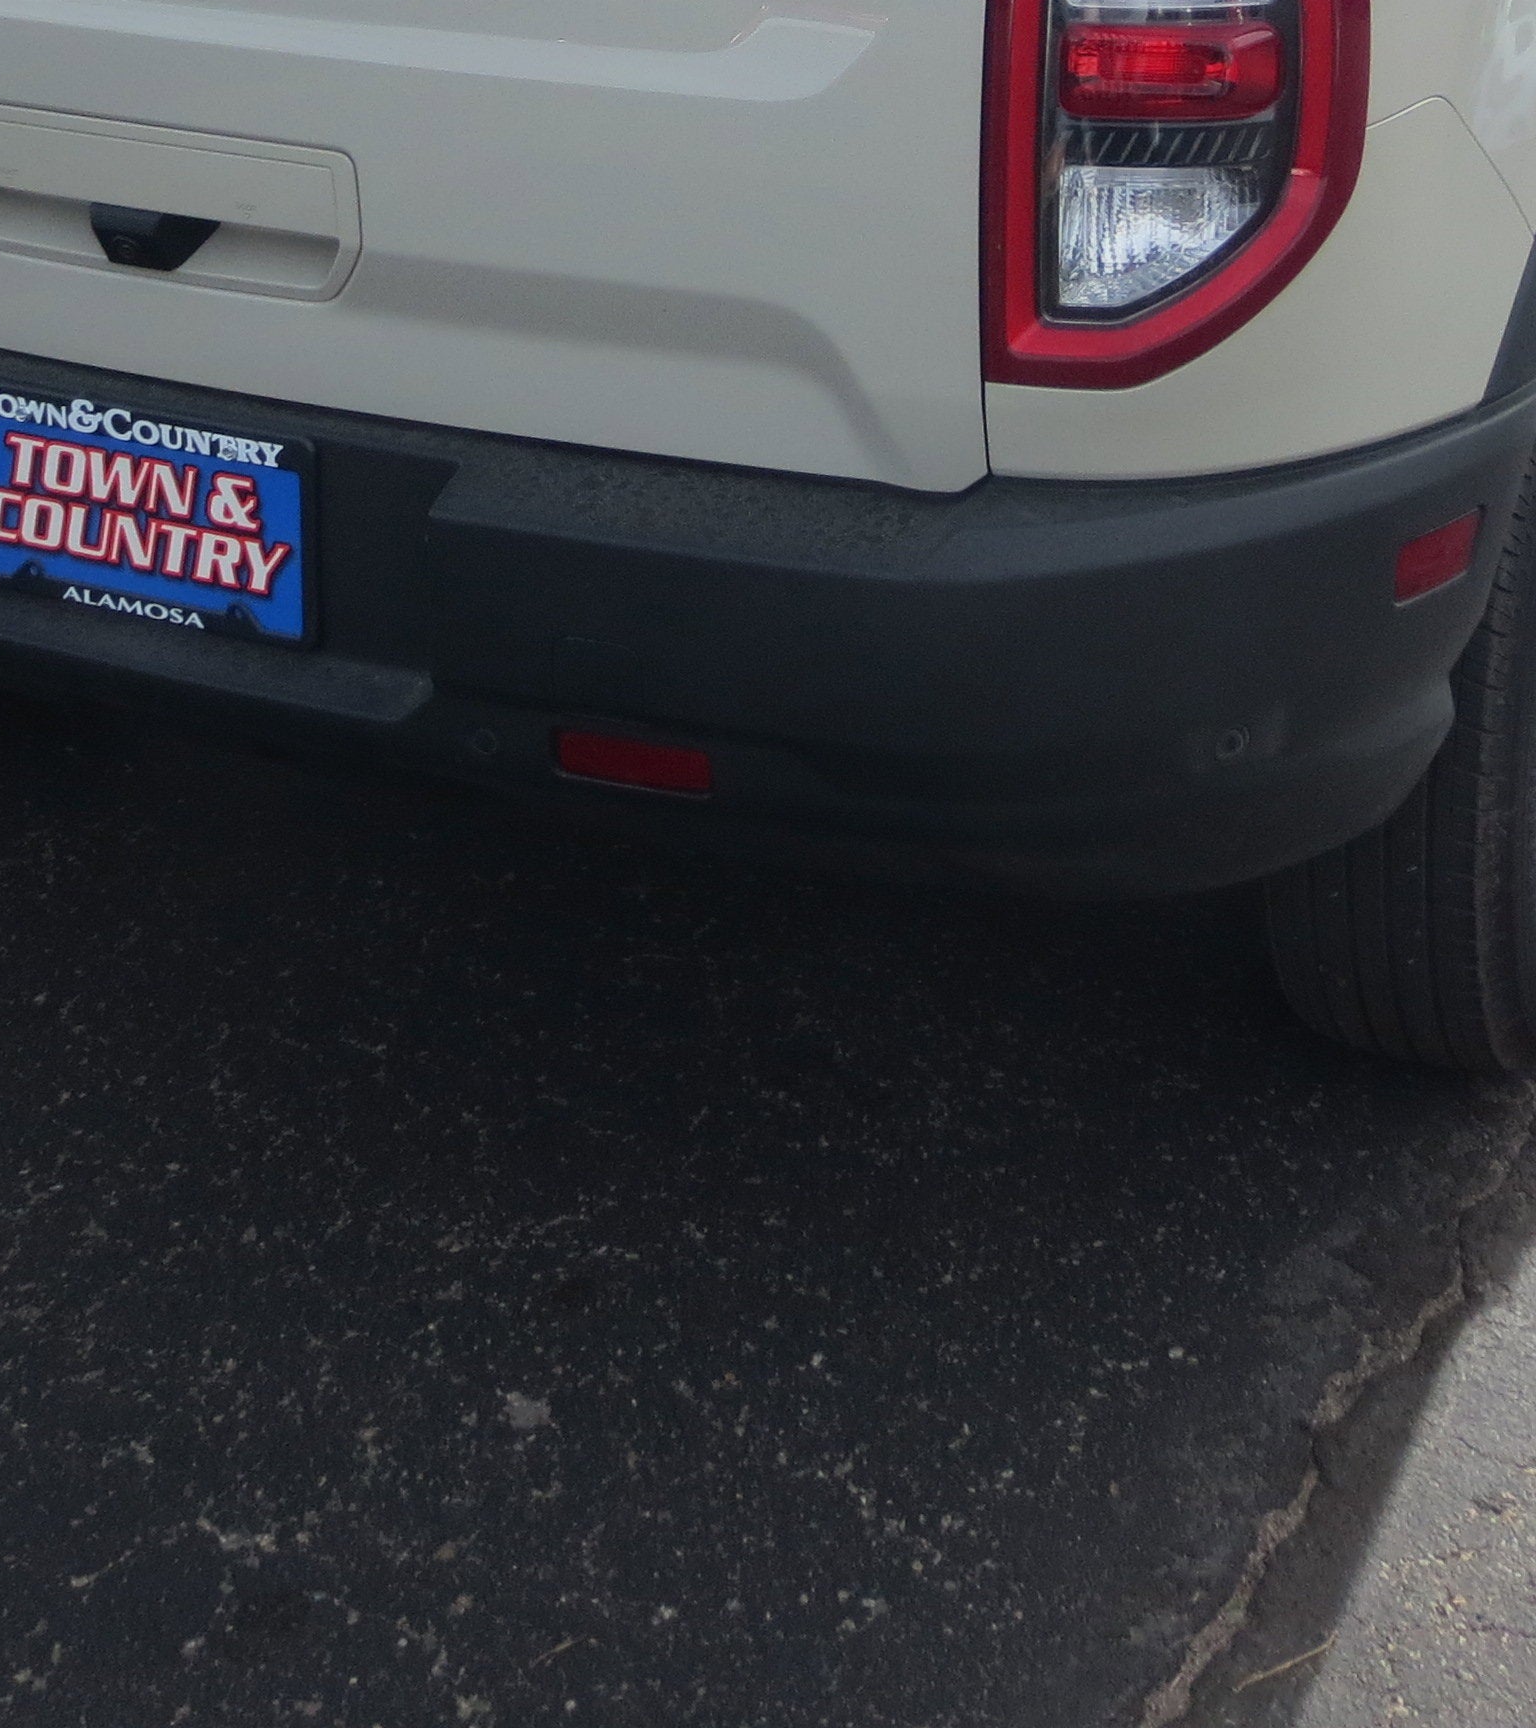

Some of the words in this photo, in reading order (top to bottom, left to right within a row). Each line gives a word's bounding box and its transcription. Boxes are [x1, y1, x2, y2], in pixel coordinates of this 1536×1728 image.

[5, 430, 199, 519] TOWN
[206, 470, 261, 532] &
[63, 585, 205, 630] ALAMOSA
